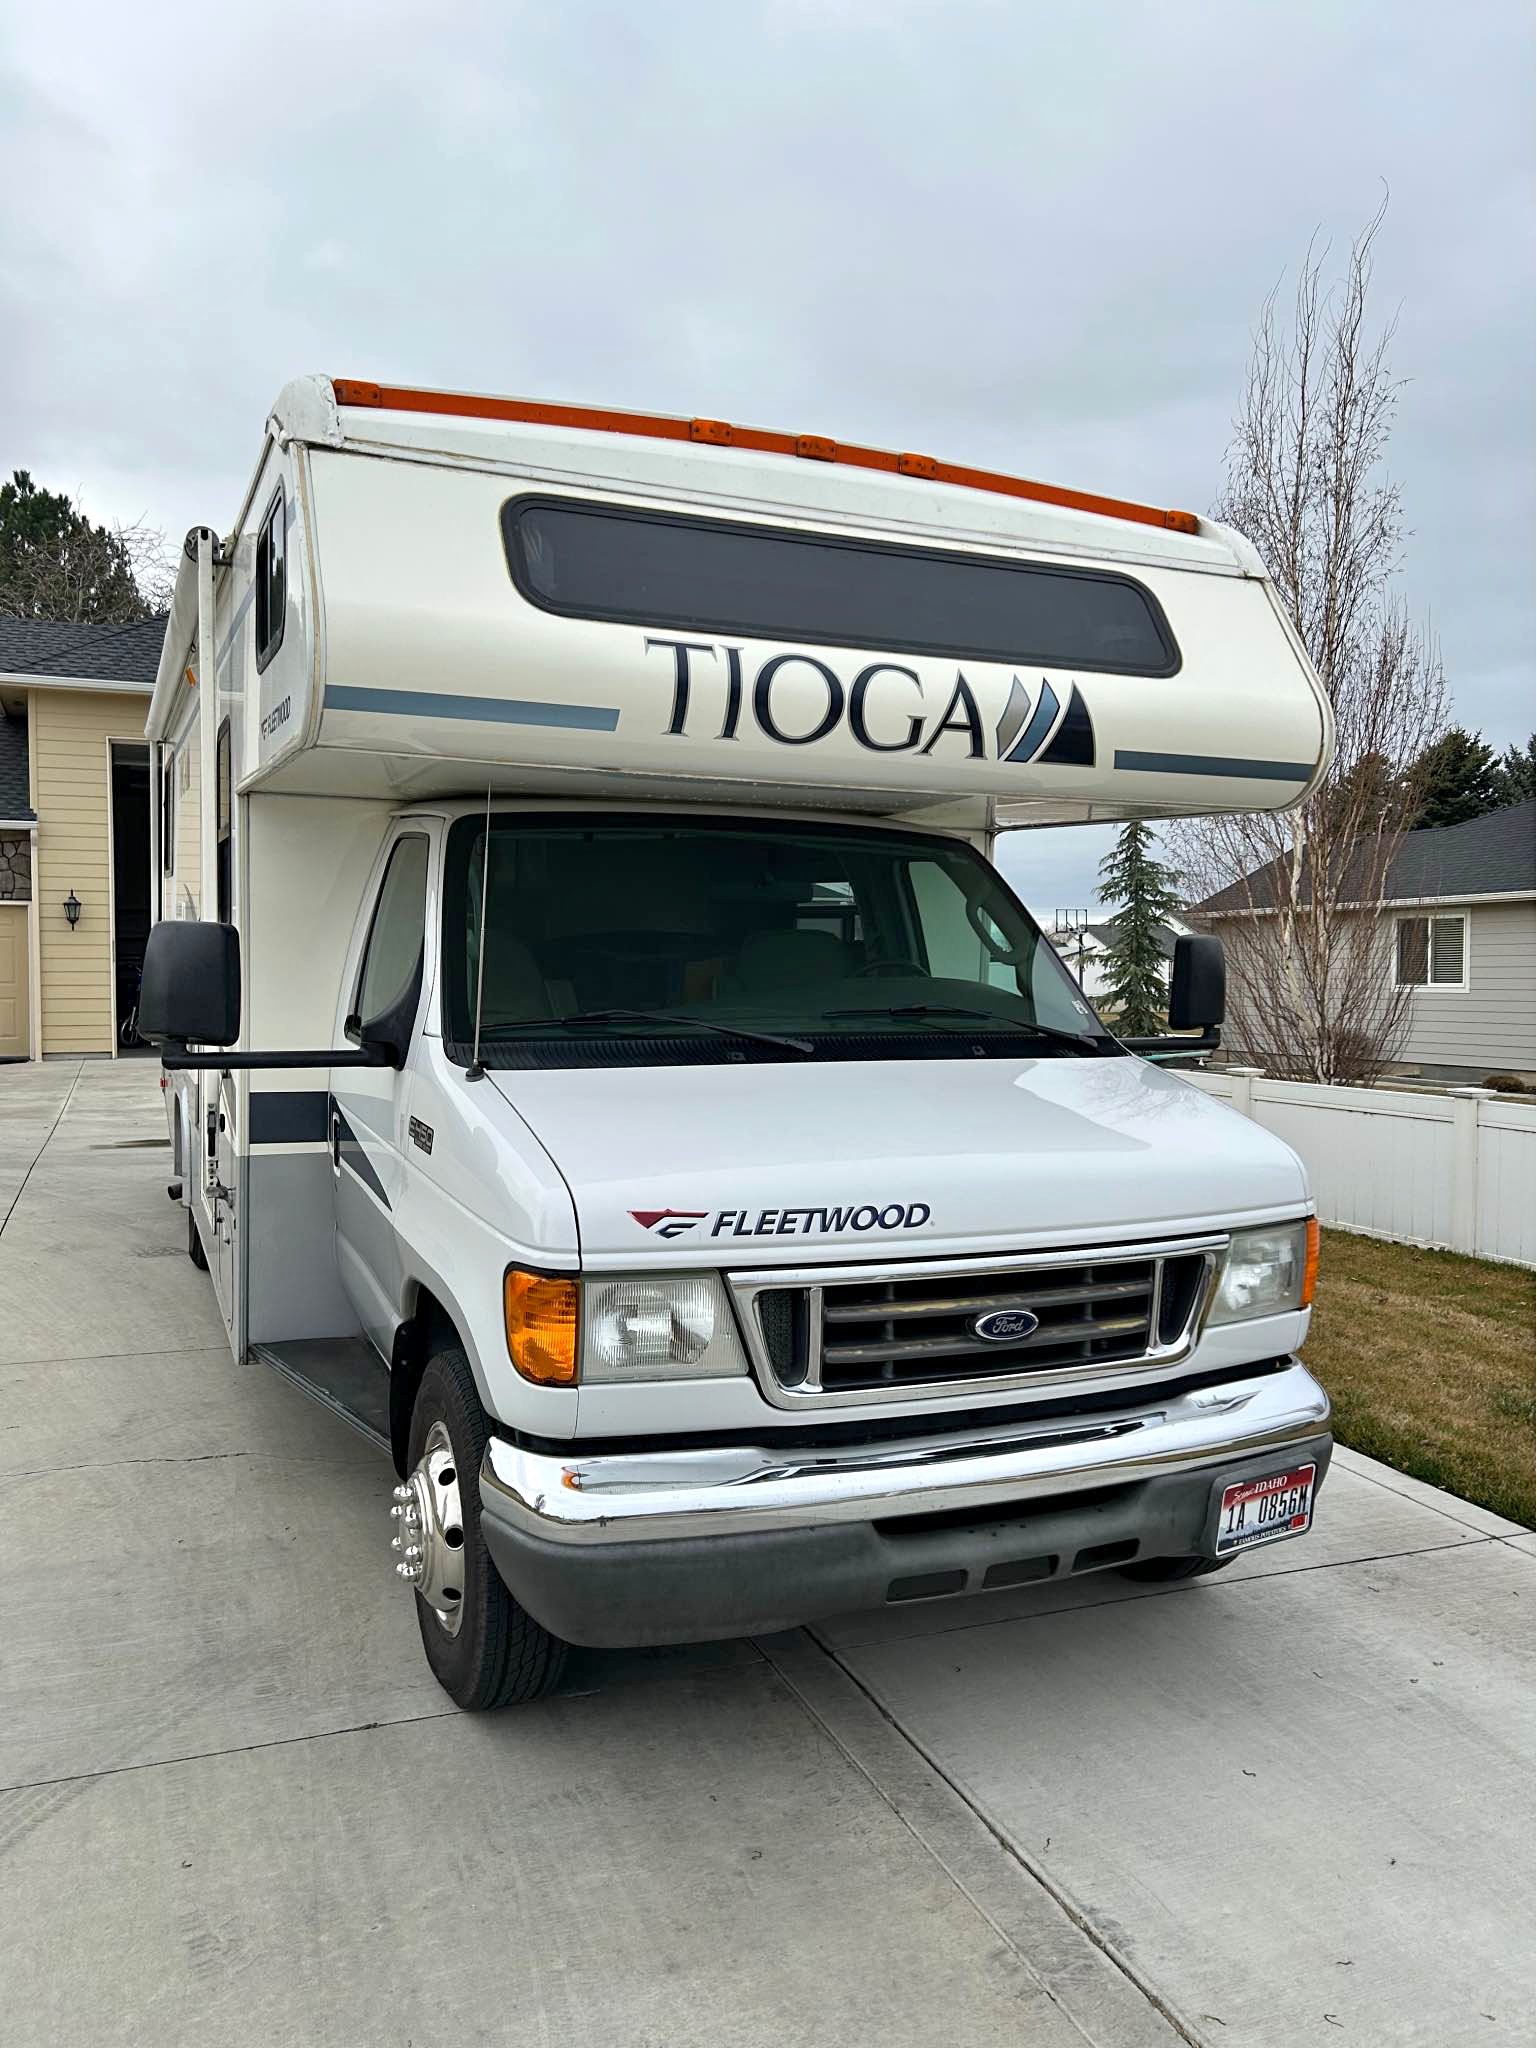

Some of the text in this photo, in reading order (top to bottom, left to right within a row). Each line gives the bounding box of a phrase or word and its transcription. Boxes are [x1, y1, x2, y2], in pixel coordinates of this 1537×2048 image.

[643, 635, 989, 761] TIOGA
[711, 1203, 931, 1237] FLEETWOOD
[992, 1316, 1024, 1334] Ford
[1254, 1475, 1288, 1494] IDAHO
[1225, 1501, 1247, 1535] 1A
